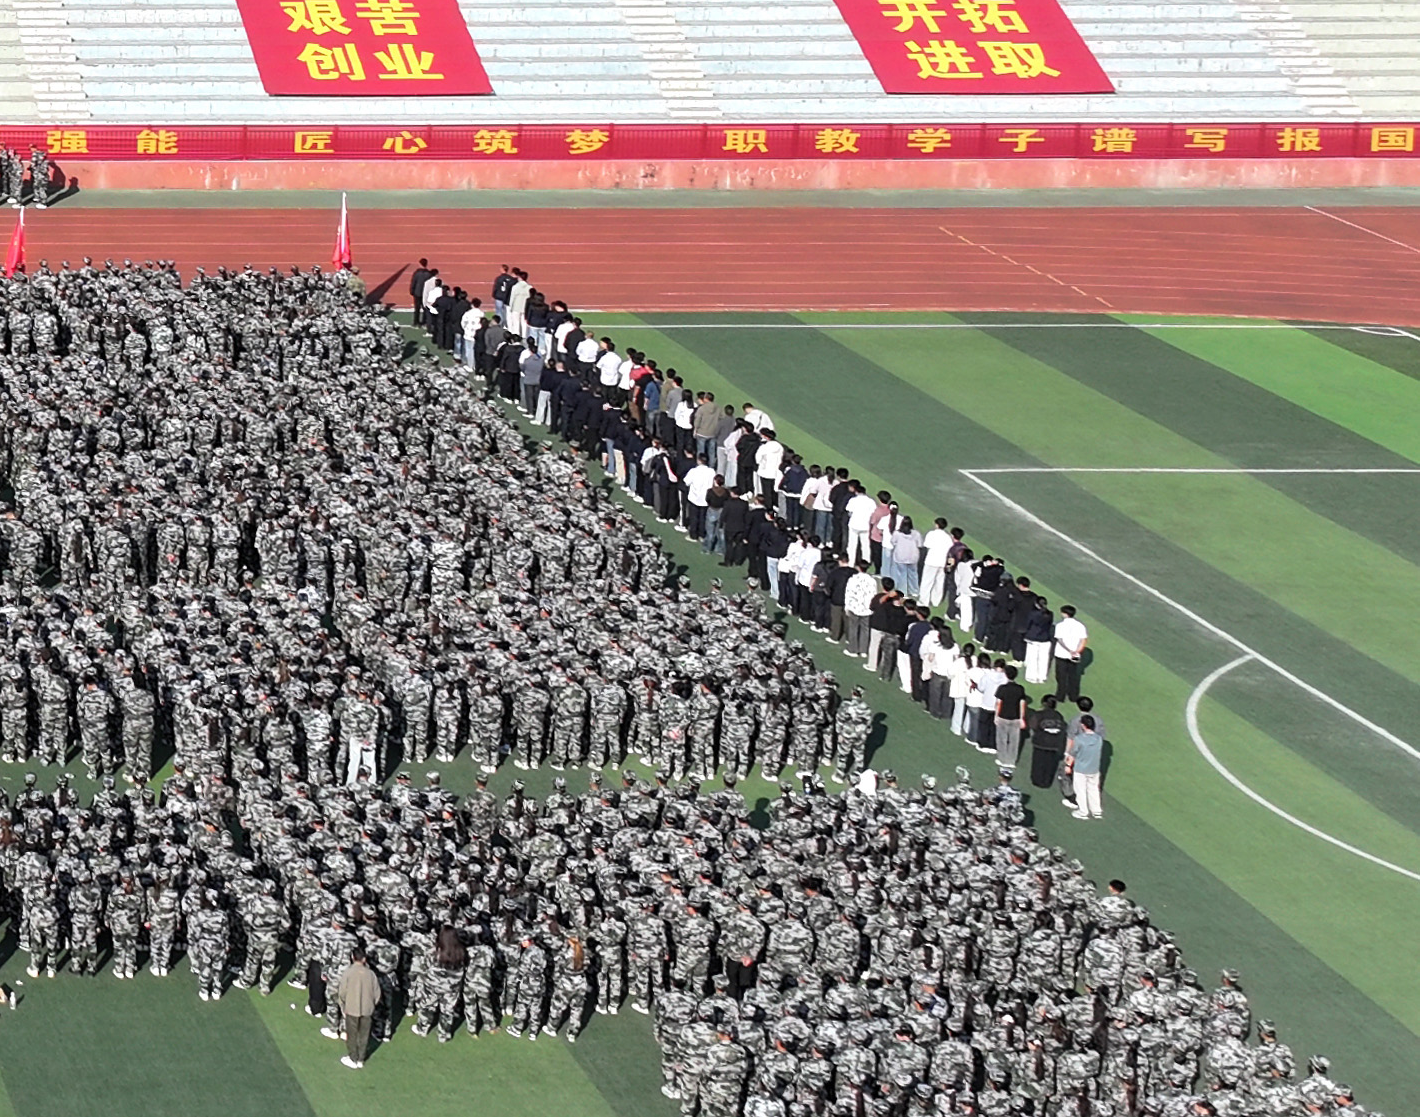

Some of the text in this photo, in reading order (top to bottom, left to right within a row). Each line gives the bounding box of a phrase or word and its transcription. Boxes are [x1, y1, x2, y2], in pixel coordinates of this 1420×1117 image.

[279, 0, 421, 36] 艰苦
[297, 42, 445, 81] 创业
[904, 40, 1061, 79] 进取
[294, 129, 610, 155] 匠心筑梦
[723, 127, 1415, 154] 职教学子谱写报国
